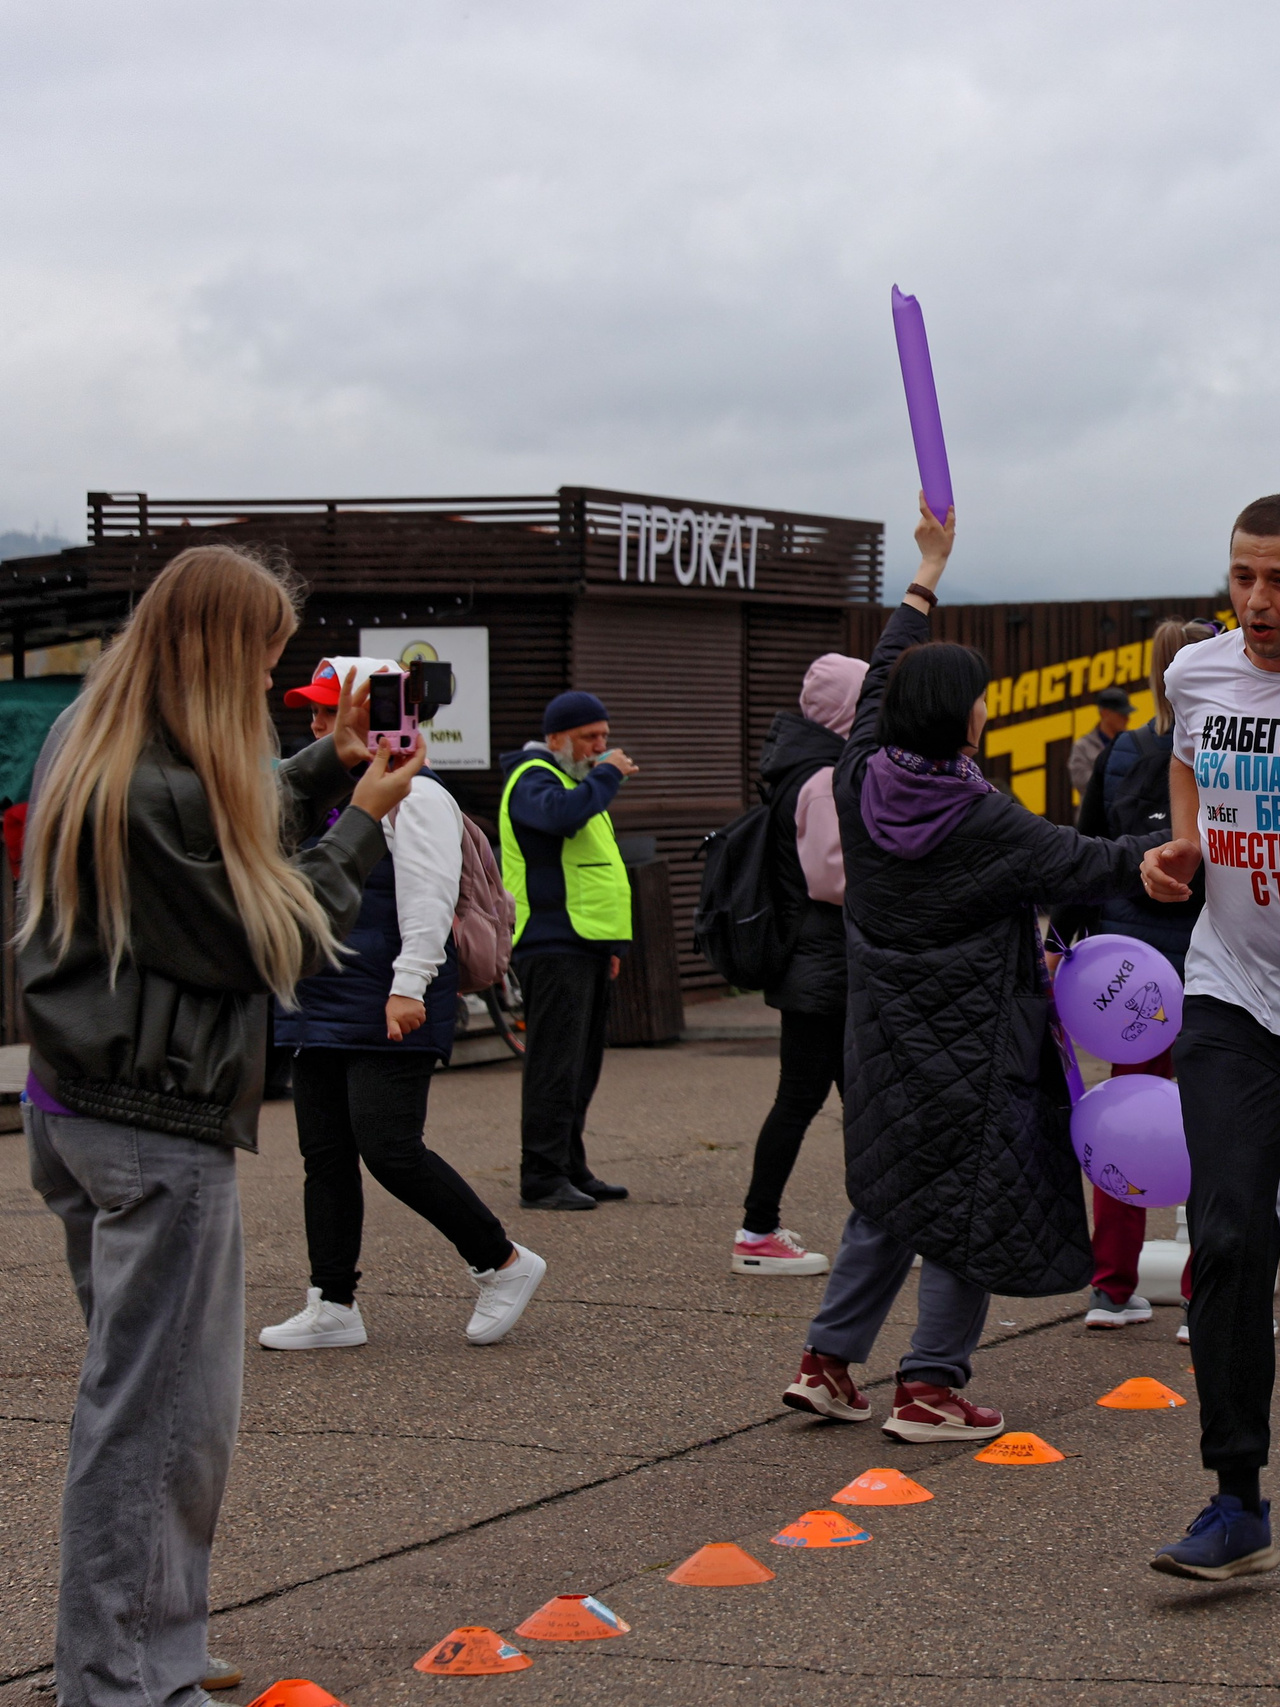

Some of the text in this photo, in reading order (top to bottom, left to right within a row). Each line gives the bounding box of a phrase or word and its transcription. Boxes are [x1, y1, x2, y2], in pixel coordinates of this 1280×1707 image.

[619, 502, 768, 590] ПРОКАТ
[986, 637, 1156, 721] НАСТОЯ
[1206, 802, 1239, 825] ЗАБЕГ
[1250, 870, 1271, 907] С
[1092, 959, 1135, 1012] ВЖУХ!
